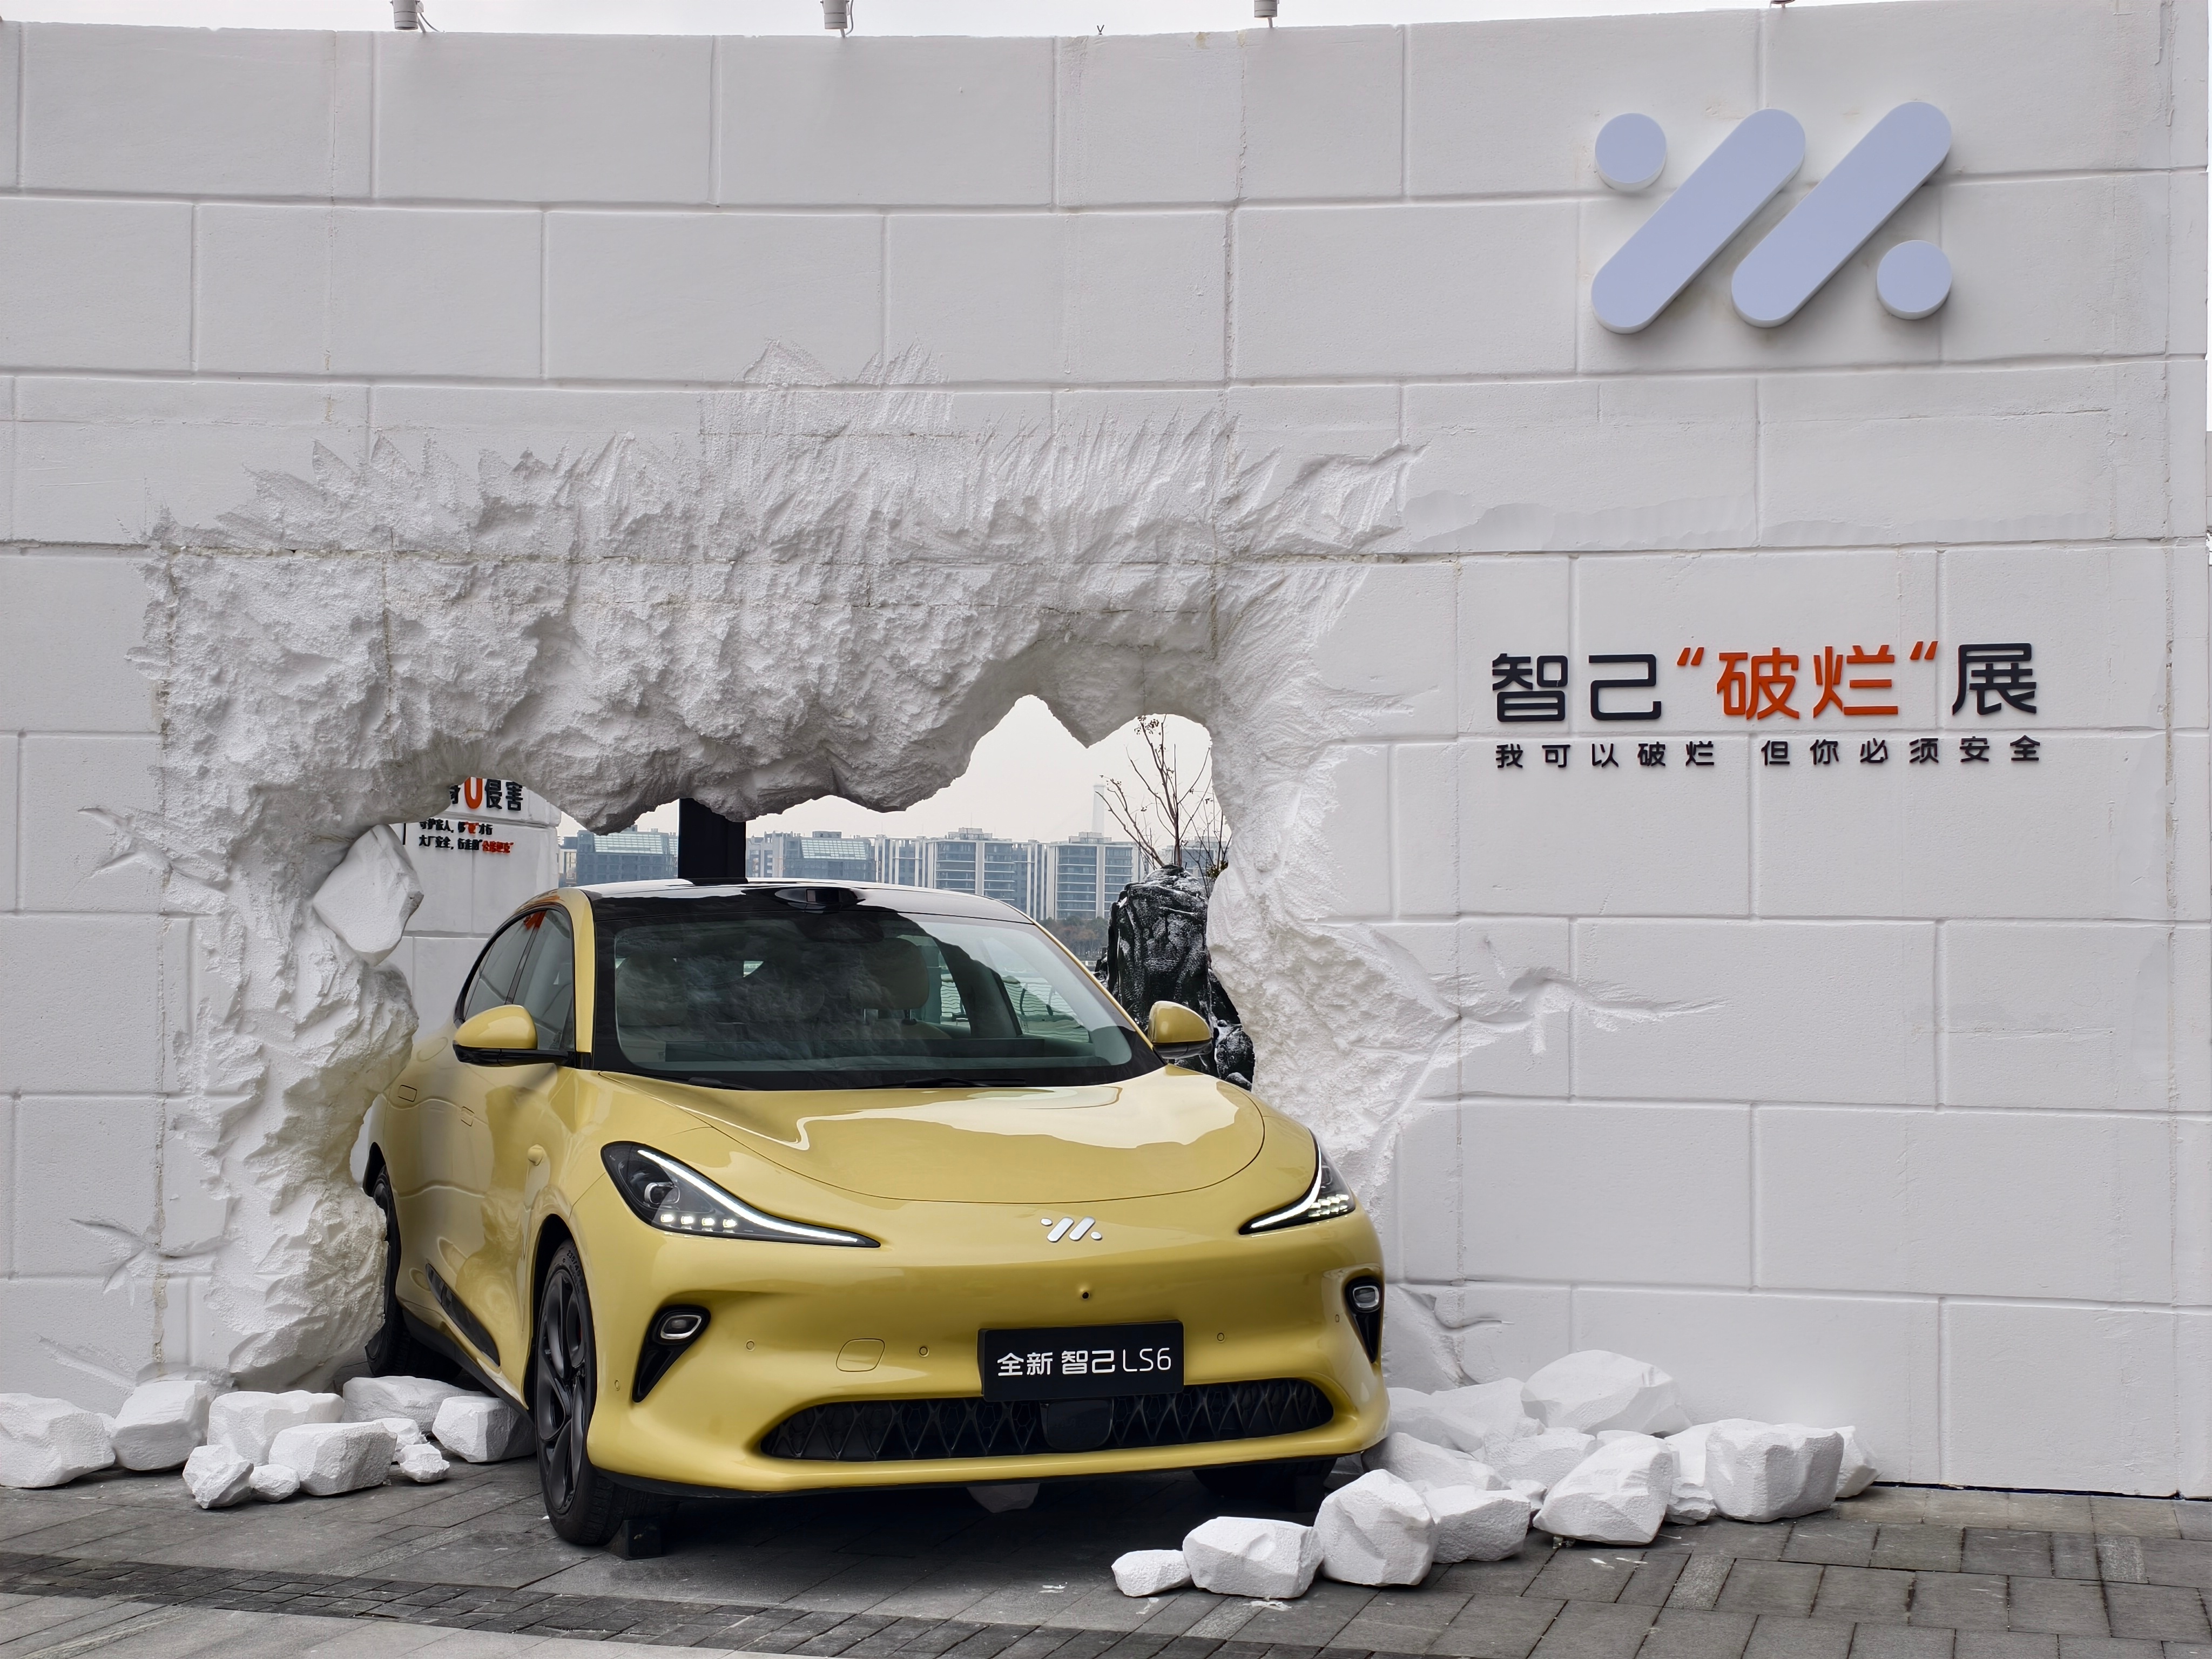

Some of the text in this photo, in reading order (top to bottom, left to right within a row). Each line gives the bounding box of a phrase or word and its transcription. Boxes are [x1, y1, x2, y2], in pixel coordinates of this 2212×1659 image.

[1495, 735, 2041, 769] 我可以破烂 但你必须安全
[997, 1352, 1054, 1376] 全新
